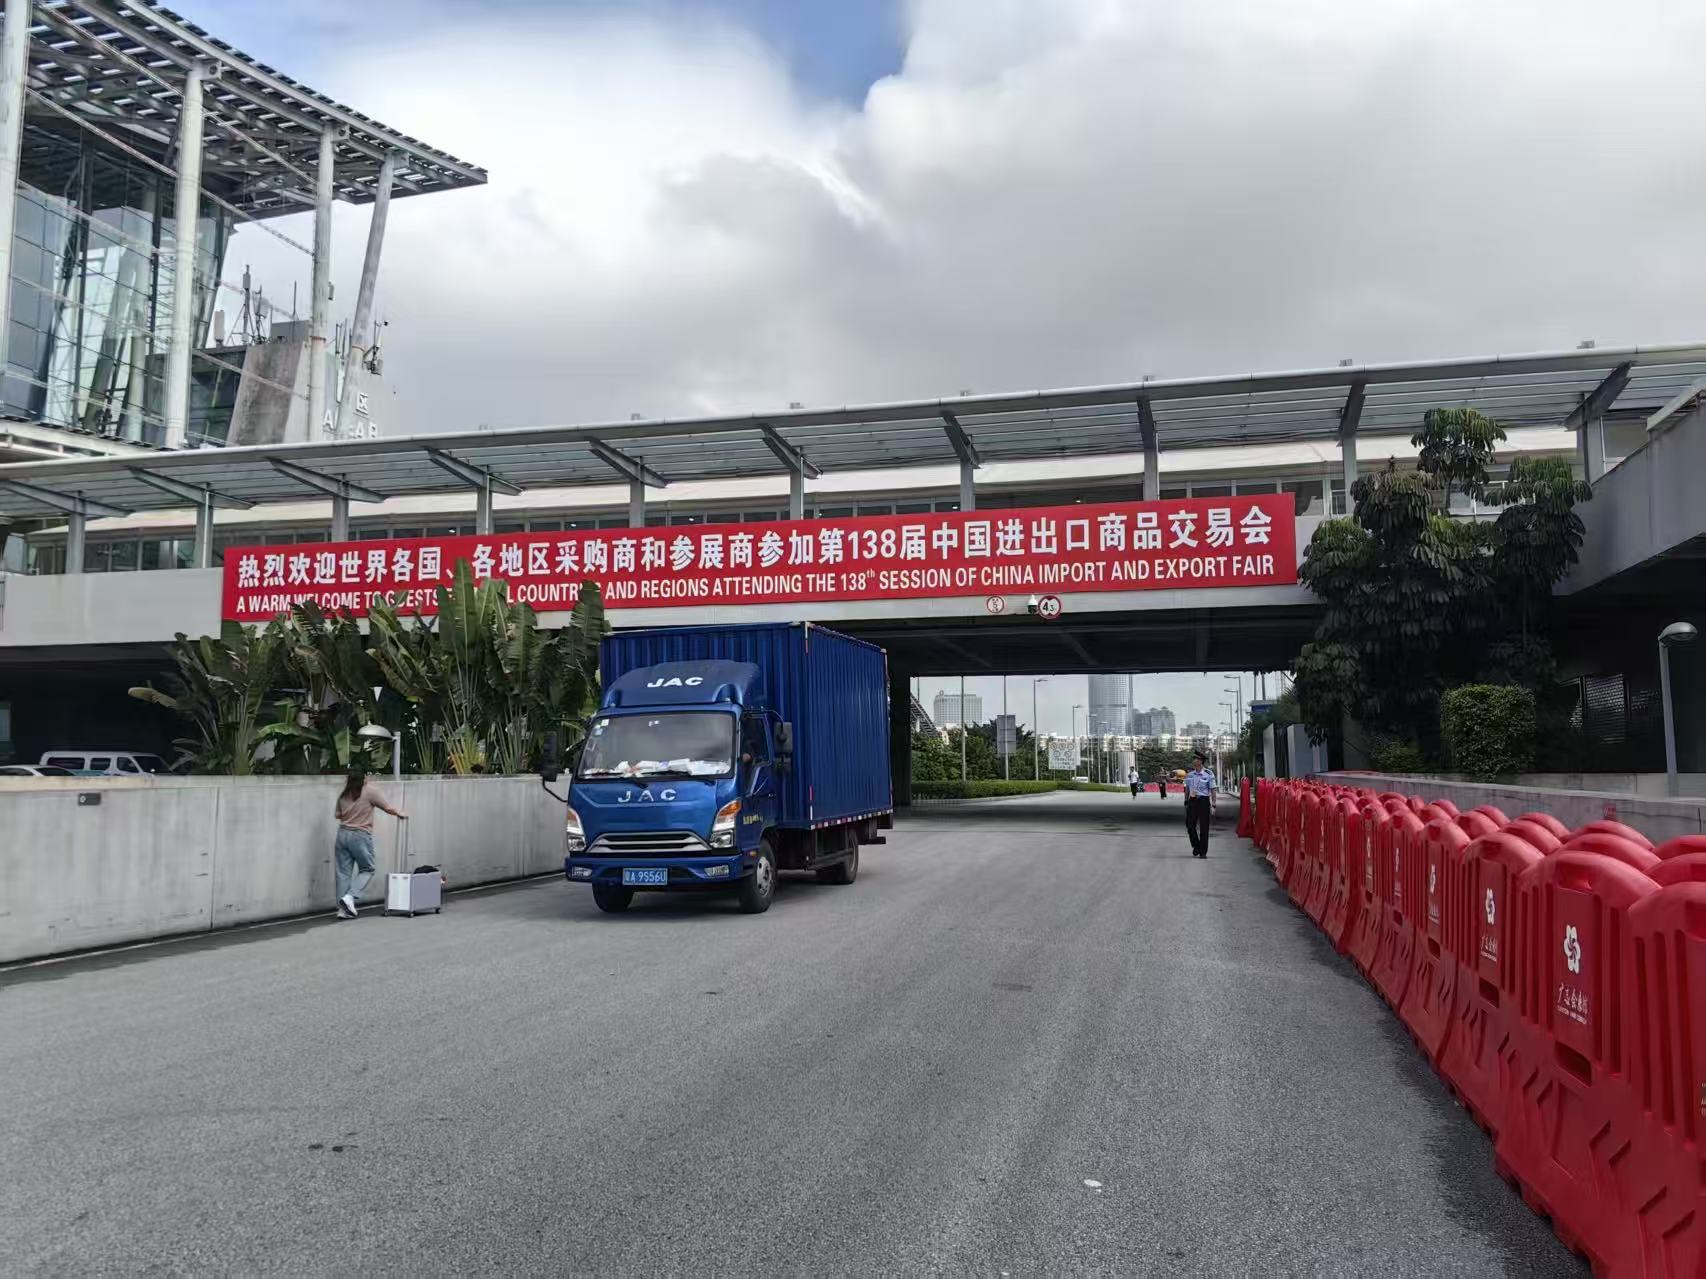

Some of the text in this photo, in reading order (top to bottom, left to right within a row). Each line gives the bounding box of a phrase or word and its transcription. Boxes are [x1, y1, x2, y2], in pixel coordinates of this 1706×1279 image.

[236, 596, 246, 612] A
[248, 594, 291, 614] WARM
[385, 587, 438, 607] GESTS
[517, 581, 602, 602] COUNTR
[604, 580, 637, 599] AND
[640, 577, 708, 598] REGIONS
[712, 574, 801, 597] ATTENDING
[805, 573, 835, 592] THE
[840, 568, 876, 591] 138th
[879, 568, 950, 589] SESSION
[955, 566, 976, 586] OF
[980, 564, 1034, 586] CHINA
[1038, 561, 1106, 584] IMPORT
[1110, 559, 1149, 580] AND
[1154, 556, 1227, 579] EXPORT
[1232, 554, 1273, 576] FAIR
[647, 676, 703, 688] JAC
[617, 788, 677, 803] JAC
